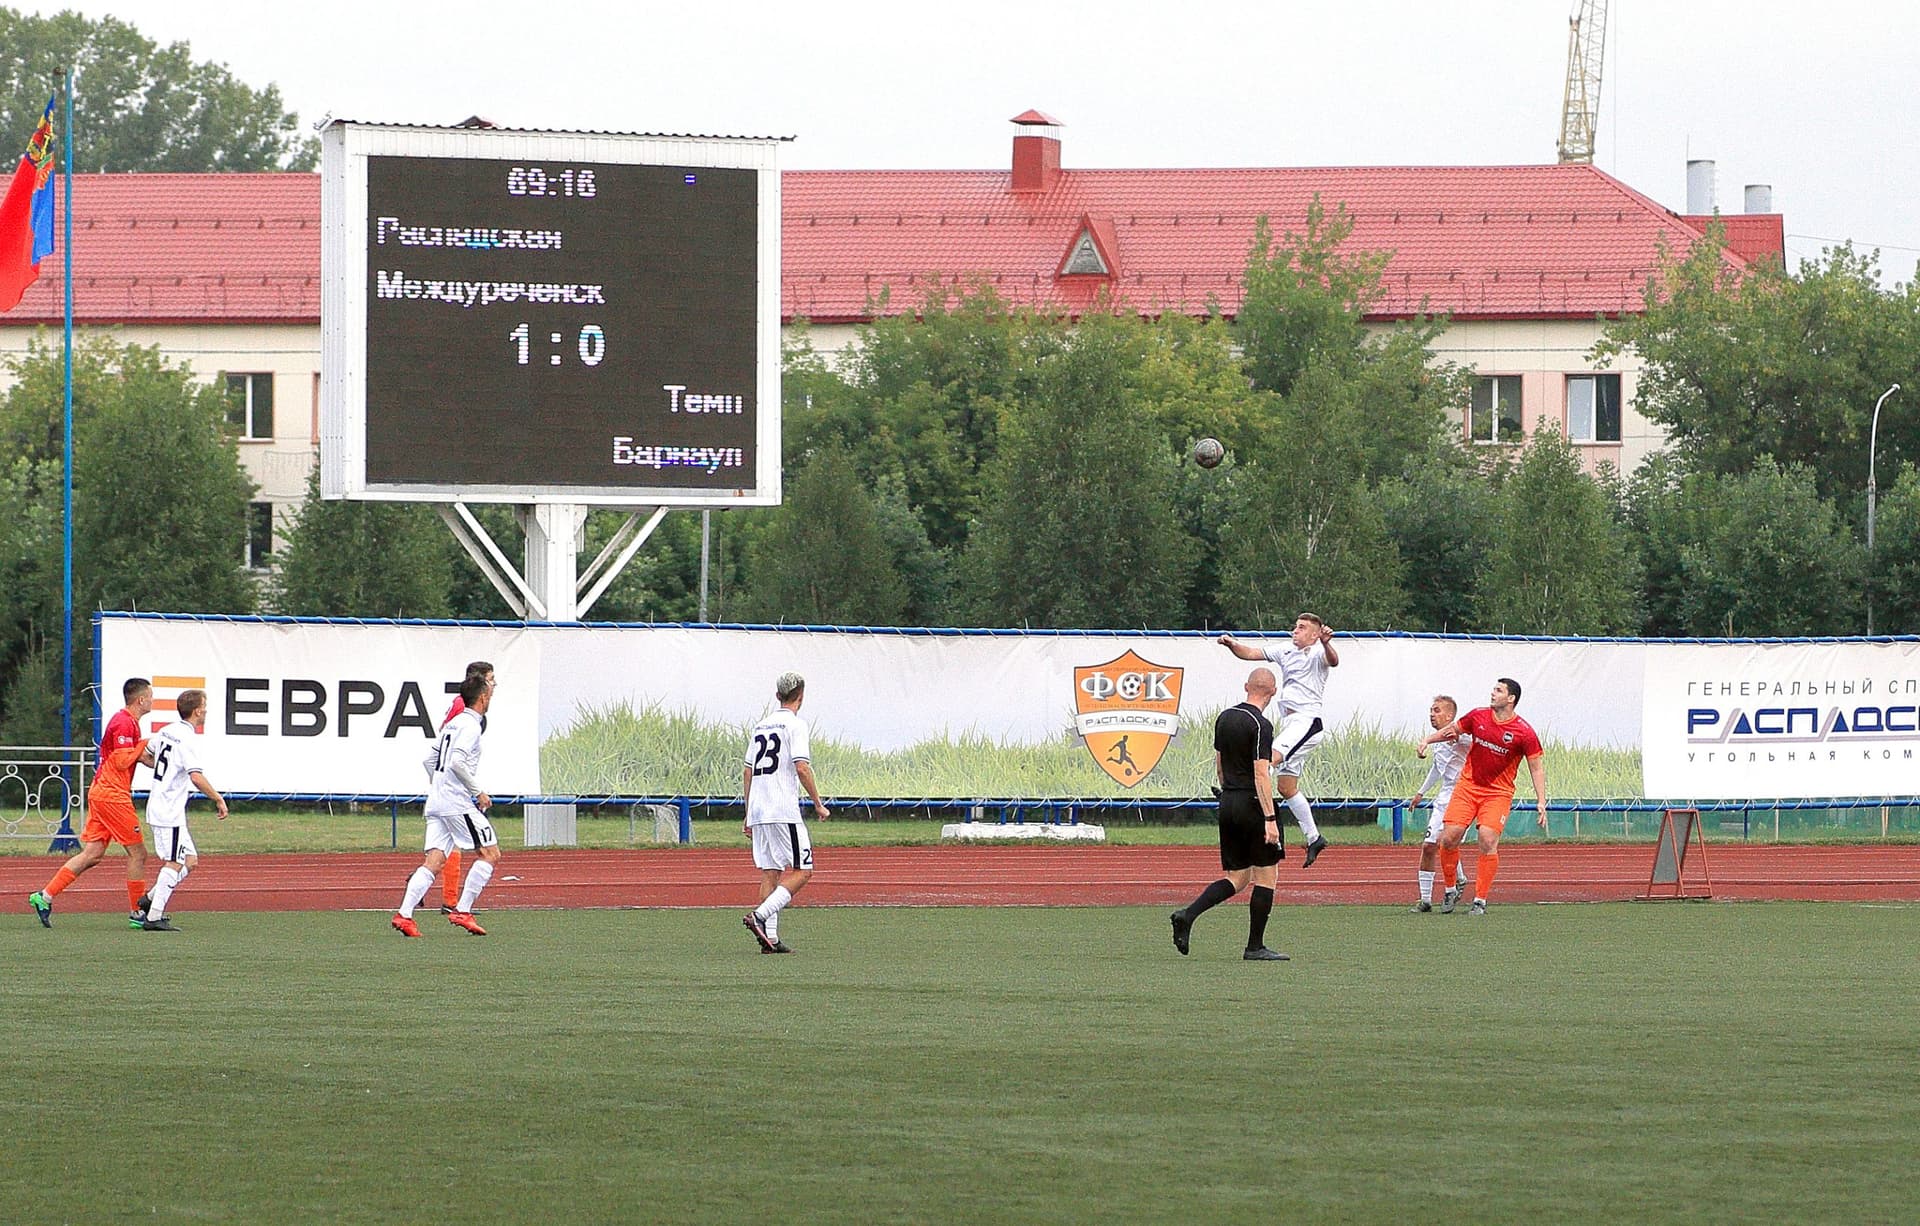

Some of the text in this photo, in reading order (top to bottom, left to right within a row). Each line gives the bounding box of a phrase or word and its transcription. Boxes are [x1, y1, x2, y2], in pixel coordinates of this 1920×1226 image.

[508, 167, 596, 196] 69:16
[377, 270, 605, 307] Междуреченск
[613, 437, 743, 474] Барнаул
[1081, 671, 1176, 701] ФСК
[1687, 677, 1917, 696] ГЕНЕРАЛЬНЫЙ СП
[1687, 705, 1920, 735] РАСПАДС
[753, 732, 782, 776] 23
[1687, 749, 1912, 763] УГОЛЬНАЯ КОМ
